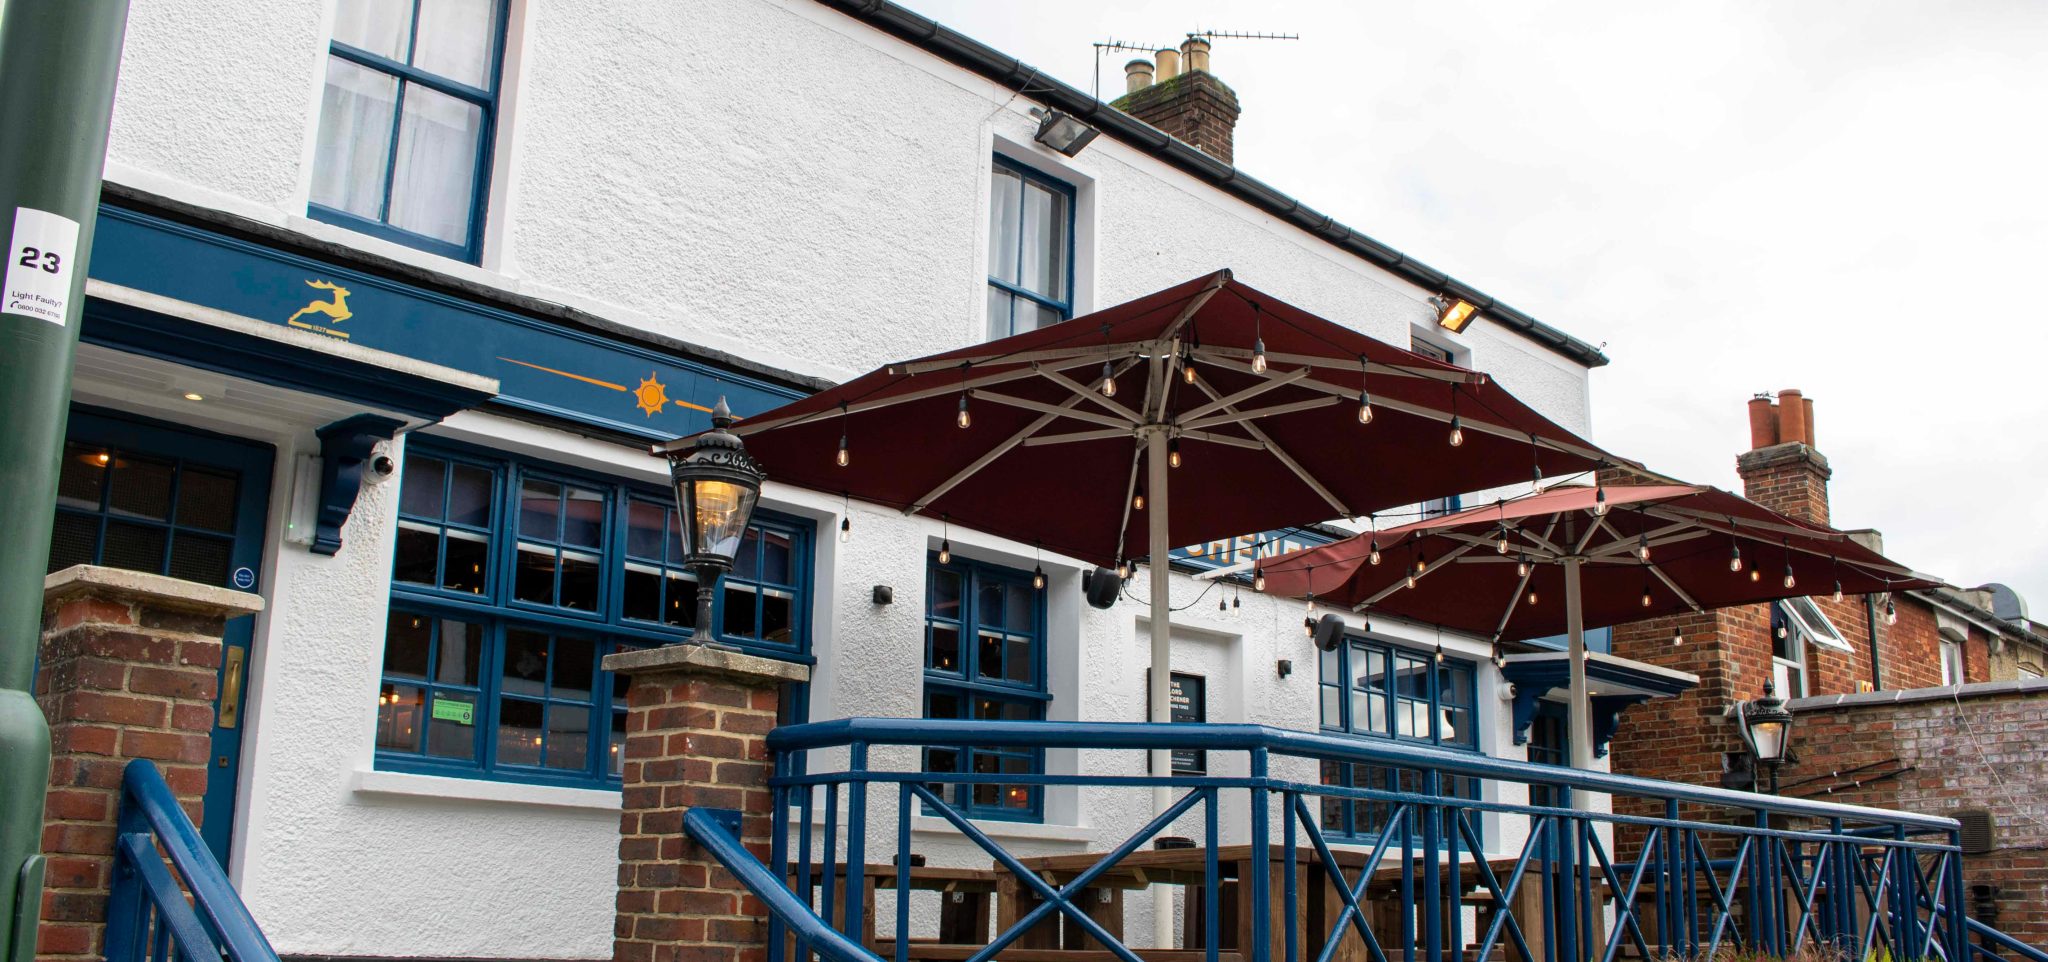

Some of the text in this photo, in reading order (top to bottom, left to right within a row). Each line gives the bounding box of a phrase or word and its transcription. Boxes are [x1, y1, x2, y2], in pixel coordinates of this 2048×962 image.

[19, 246, 60, 274] 23
[12, 290, 62, 308] Light Faulty?
[17, 304, 34, 312] 0800
[34, 307, 47, 315] 032
[1170, 688, 1182, 696] ORD
[1170, 695, 1190, 704] CHENER
